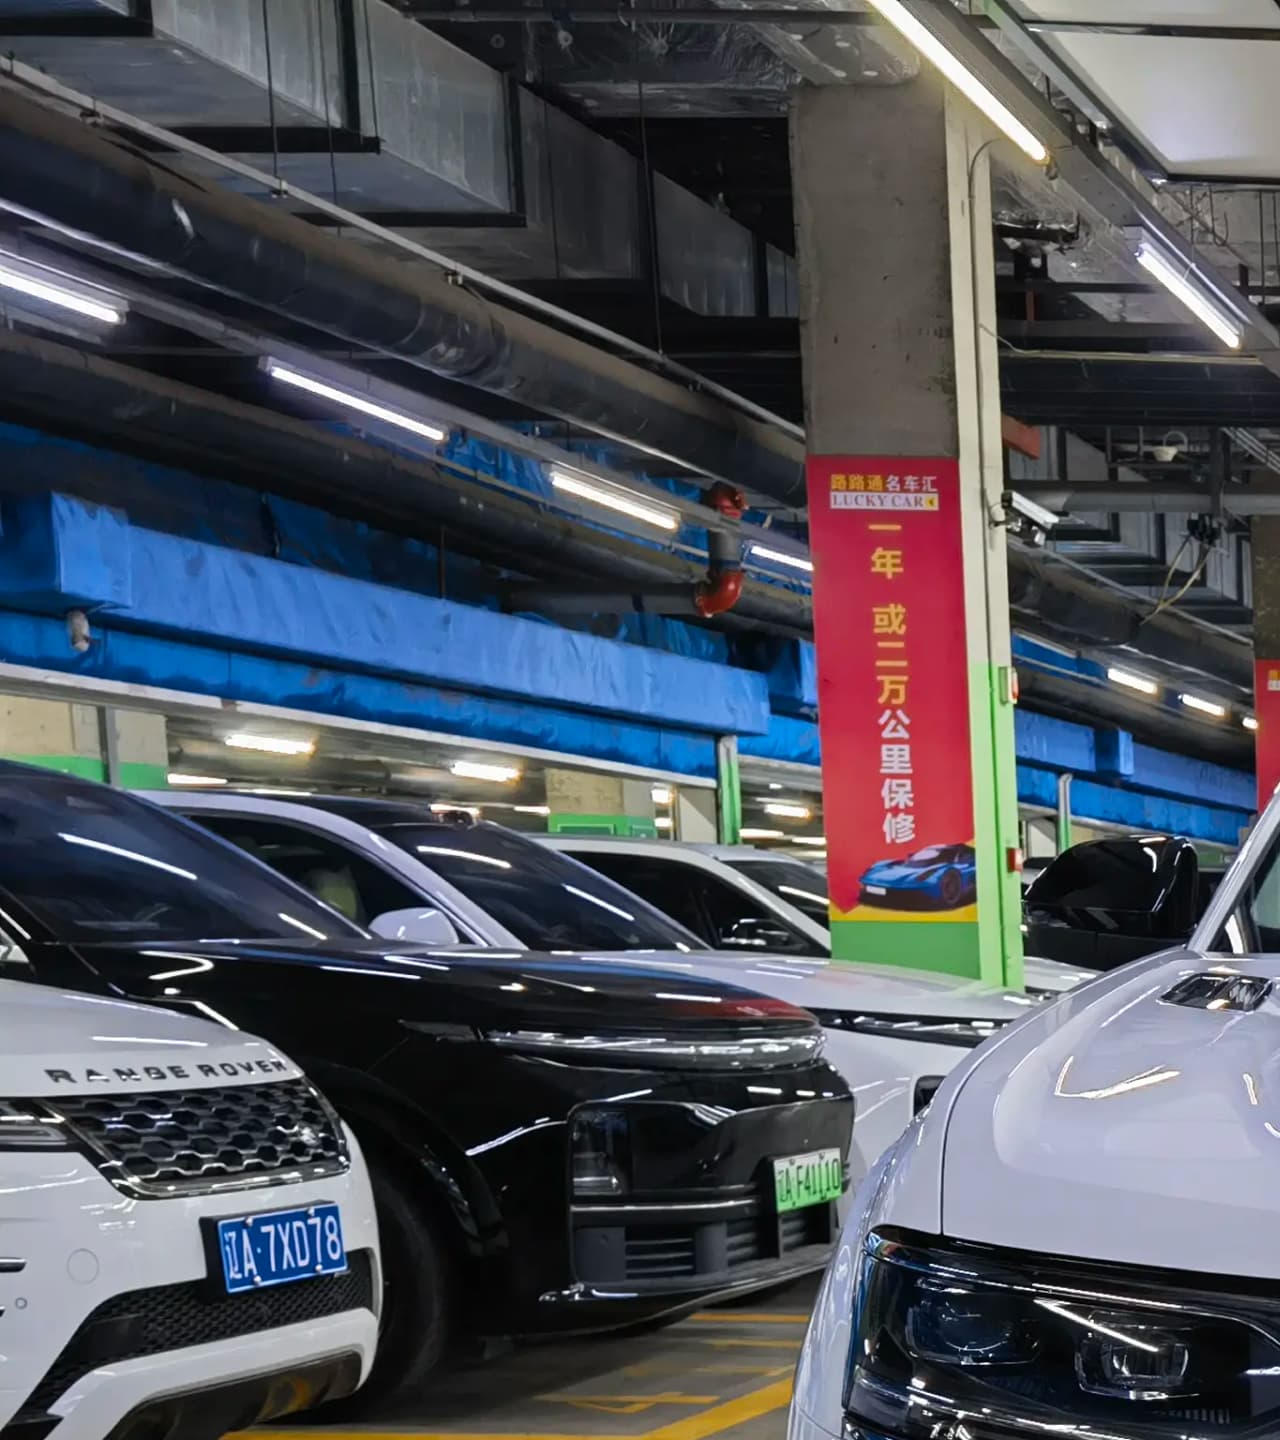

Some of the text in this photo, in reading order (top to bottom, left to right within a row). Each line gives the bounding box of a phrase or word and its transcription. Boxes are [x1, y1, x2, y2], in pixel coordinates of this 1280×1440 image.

[831, 474, 938, 492] 路路通名车汇
[832, 494, 924, 507] LUCKY CAR
[196, 1060, 287, 1077] ROVER
